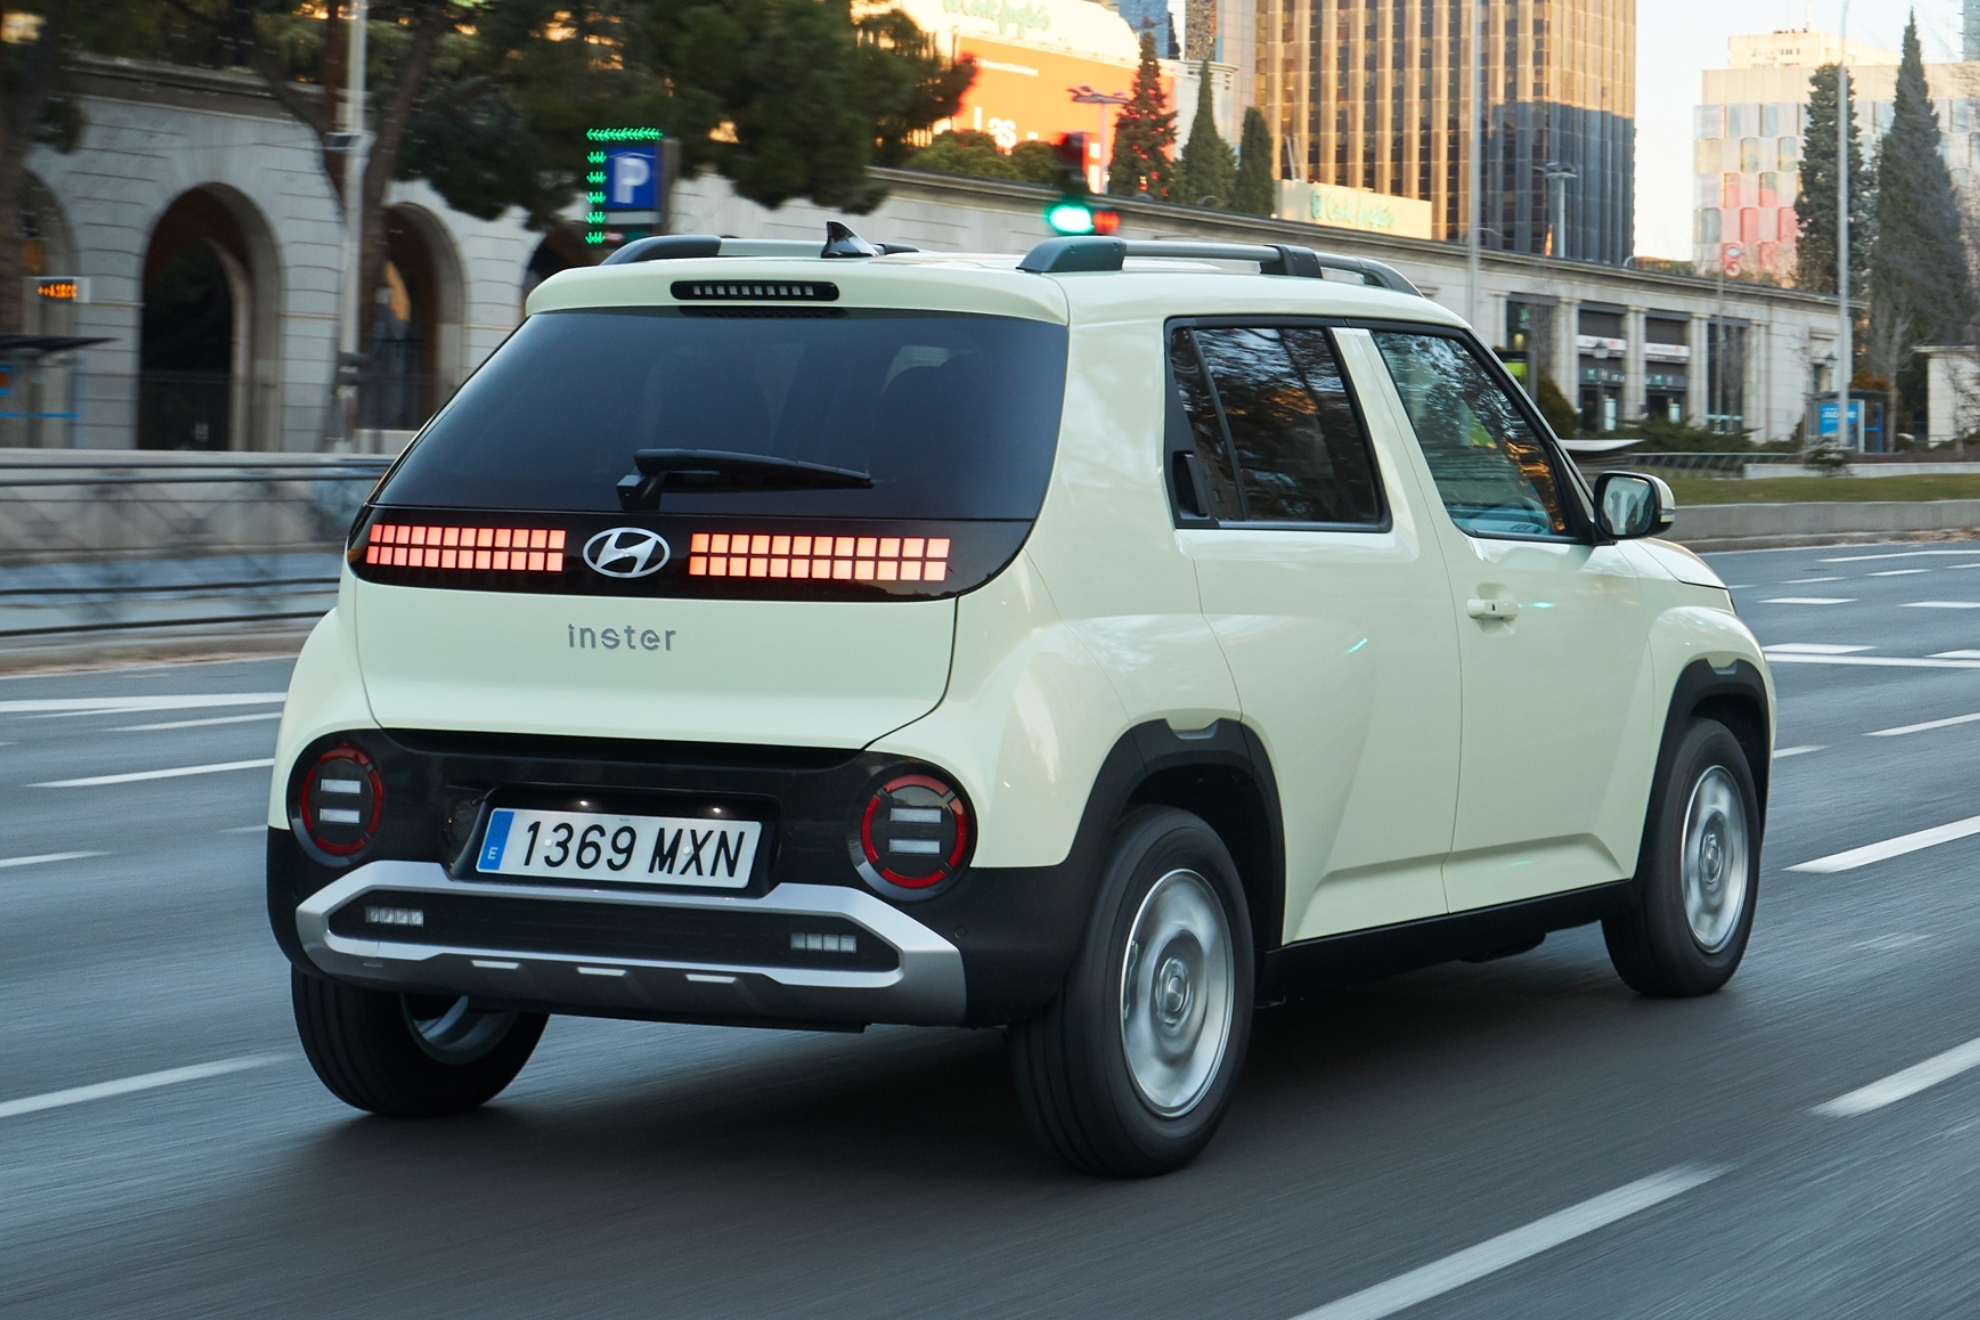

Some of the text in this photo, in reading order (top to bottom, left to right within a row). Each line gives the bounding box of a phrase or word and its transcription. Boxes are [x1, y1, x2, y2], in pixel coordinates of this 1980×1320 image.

[613, 156, 651, 204] P
[567, 623, 677, 651] inster
[486, 846, 498, 860] E
[523, 821, 746, 878] 1369 MXN
